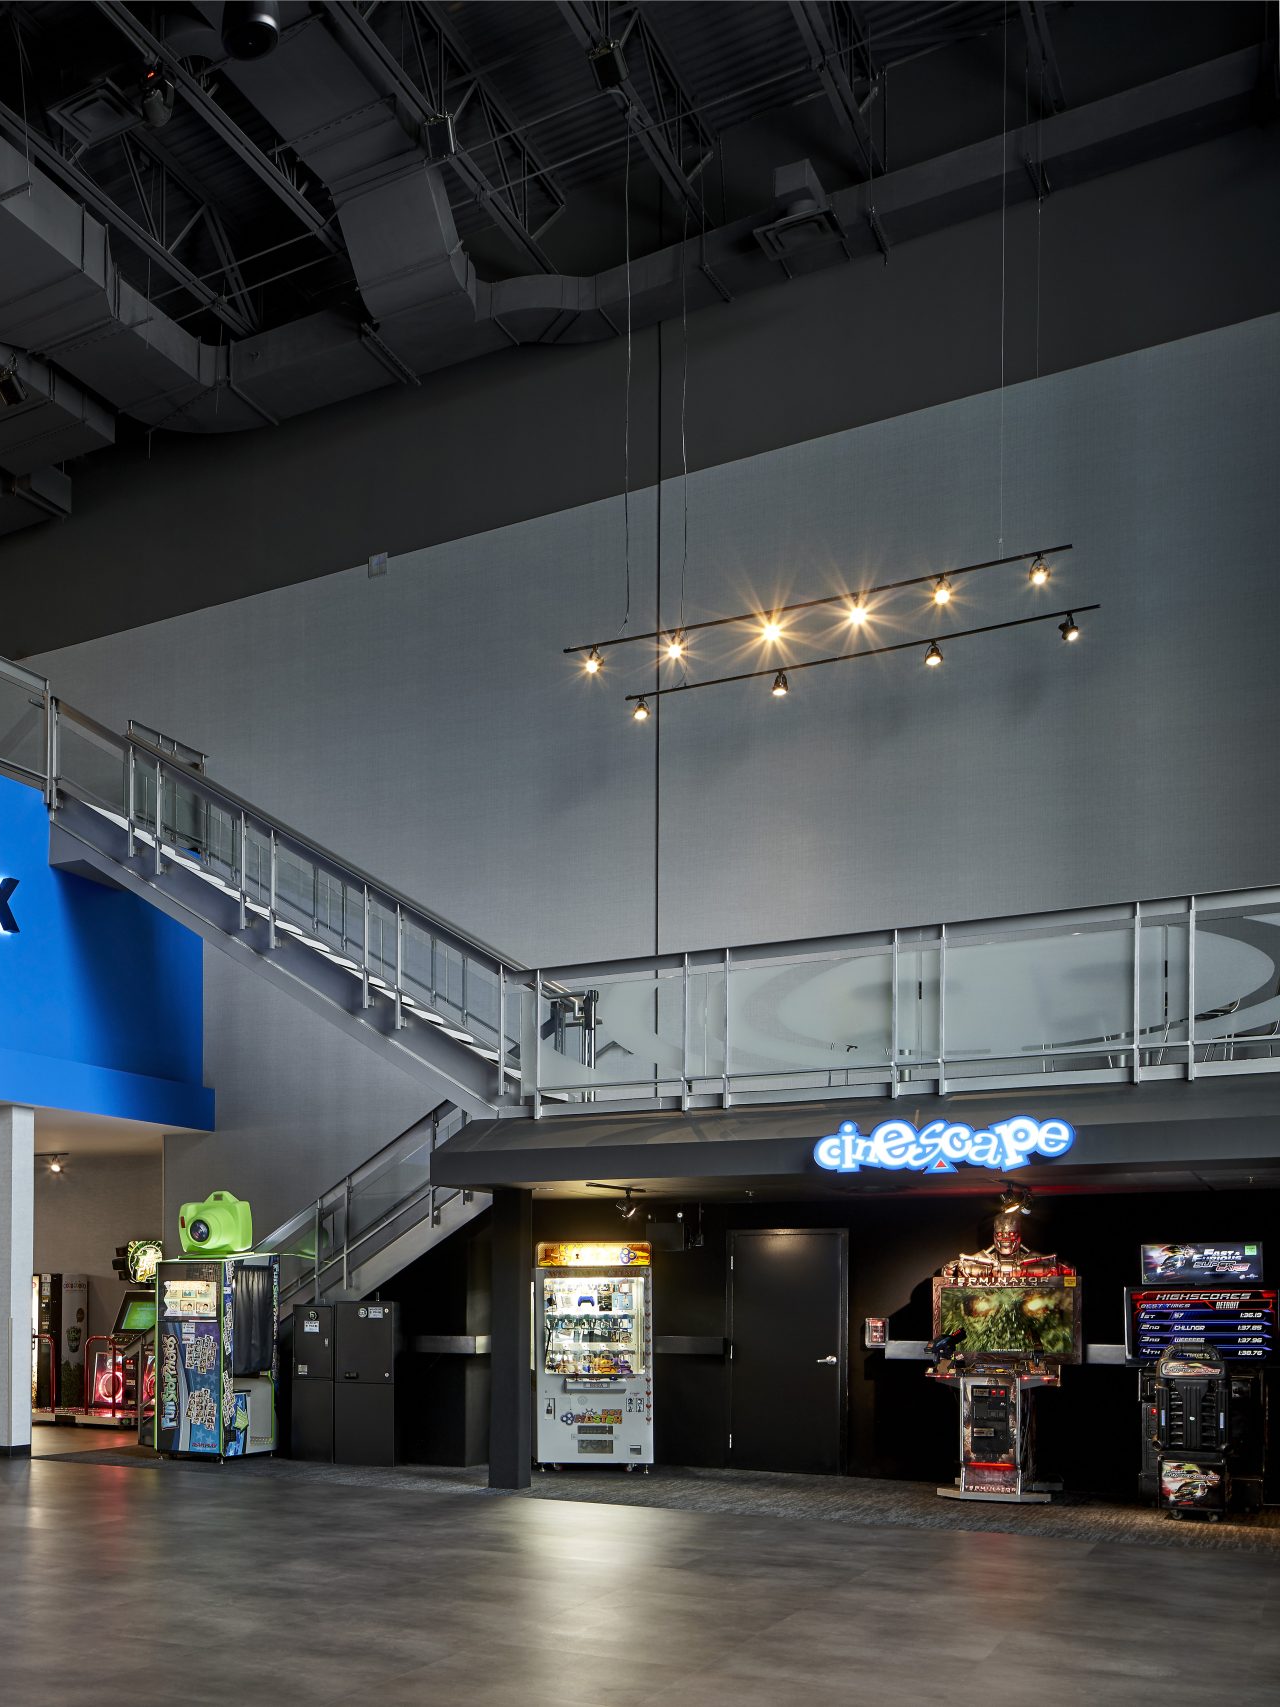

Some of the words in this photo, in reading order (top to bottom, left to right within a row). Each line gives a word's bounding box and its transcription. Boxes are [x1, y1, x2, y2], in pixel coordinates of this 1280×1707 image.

[816, 1117, 1072, 1171] cinescape
[1155, 1293, 1252, 1301] HIGHSCORES
[1215, 1301, 1240, 1309] DETROIT
